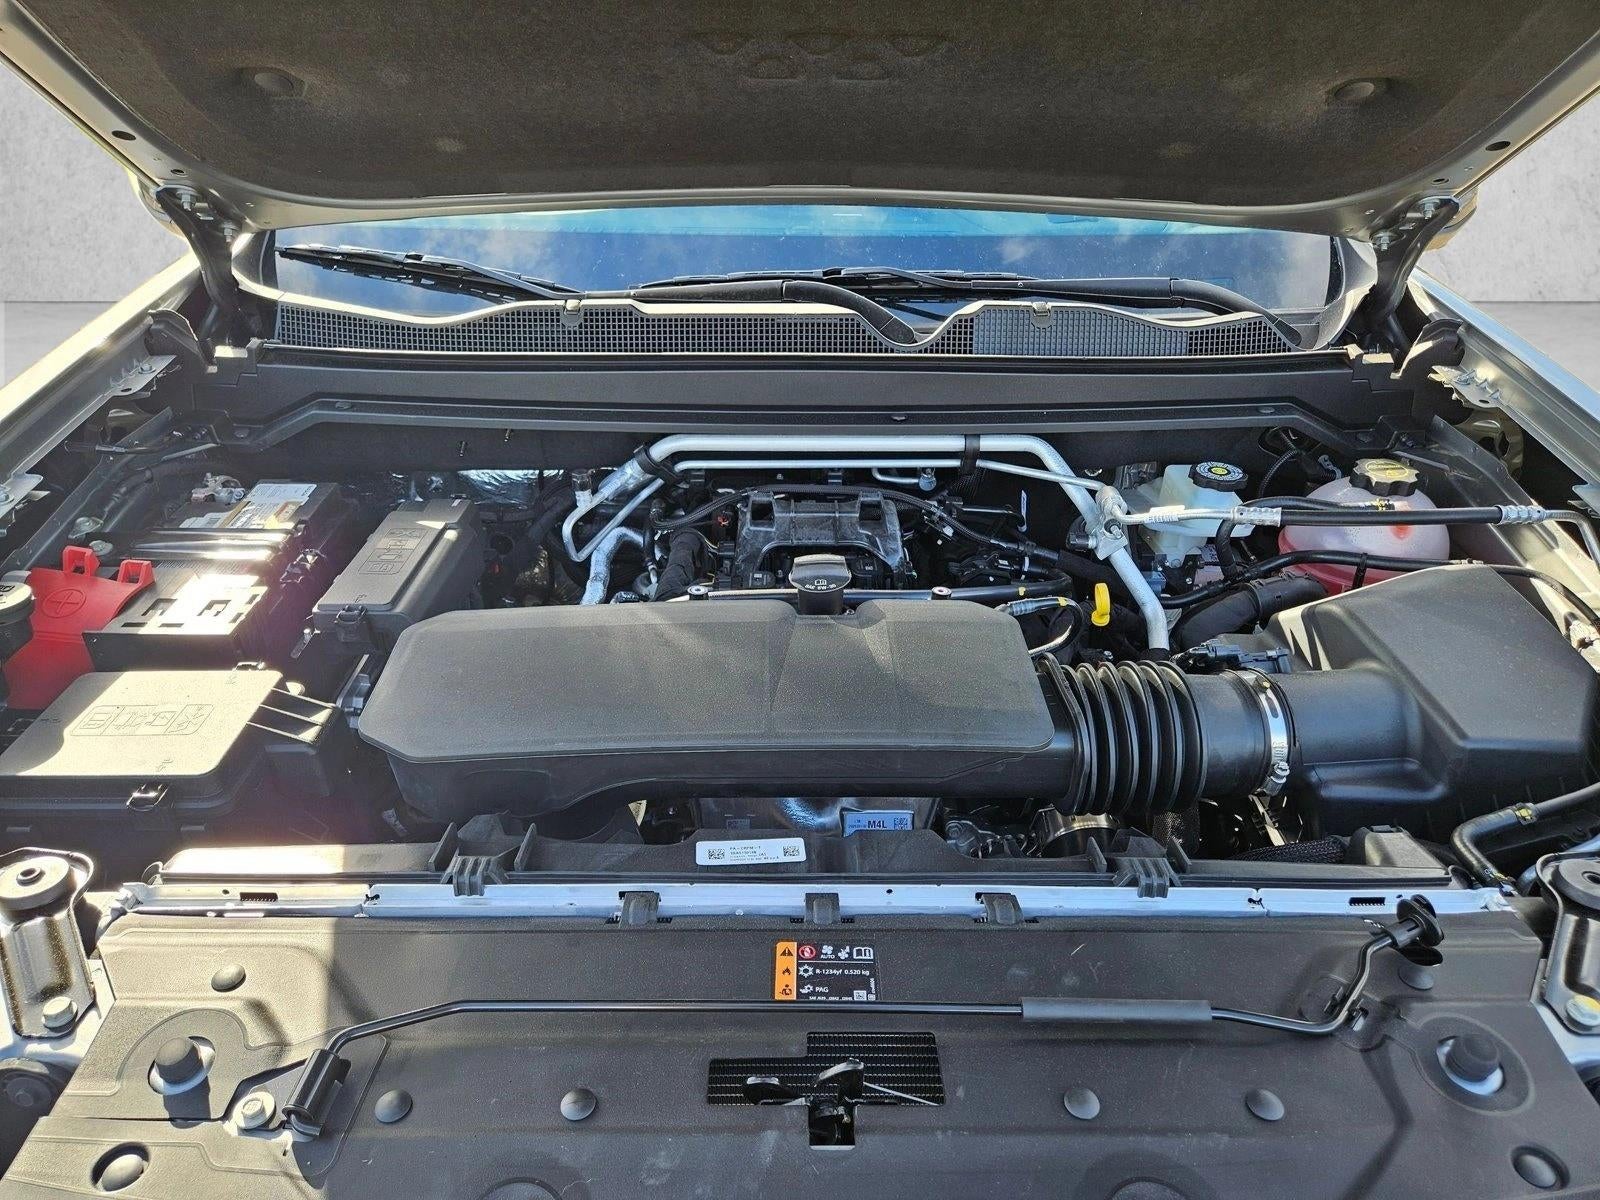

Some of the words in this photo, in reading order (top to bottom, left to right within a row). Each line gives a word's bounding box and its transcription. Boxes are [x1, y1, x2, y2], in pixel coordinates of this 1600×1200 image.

[867, 820, 888, 829] M4L
[815, 968, 842, 976] R-1234yf
[861, 968, 870, 976] kg
